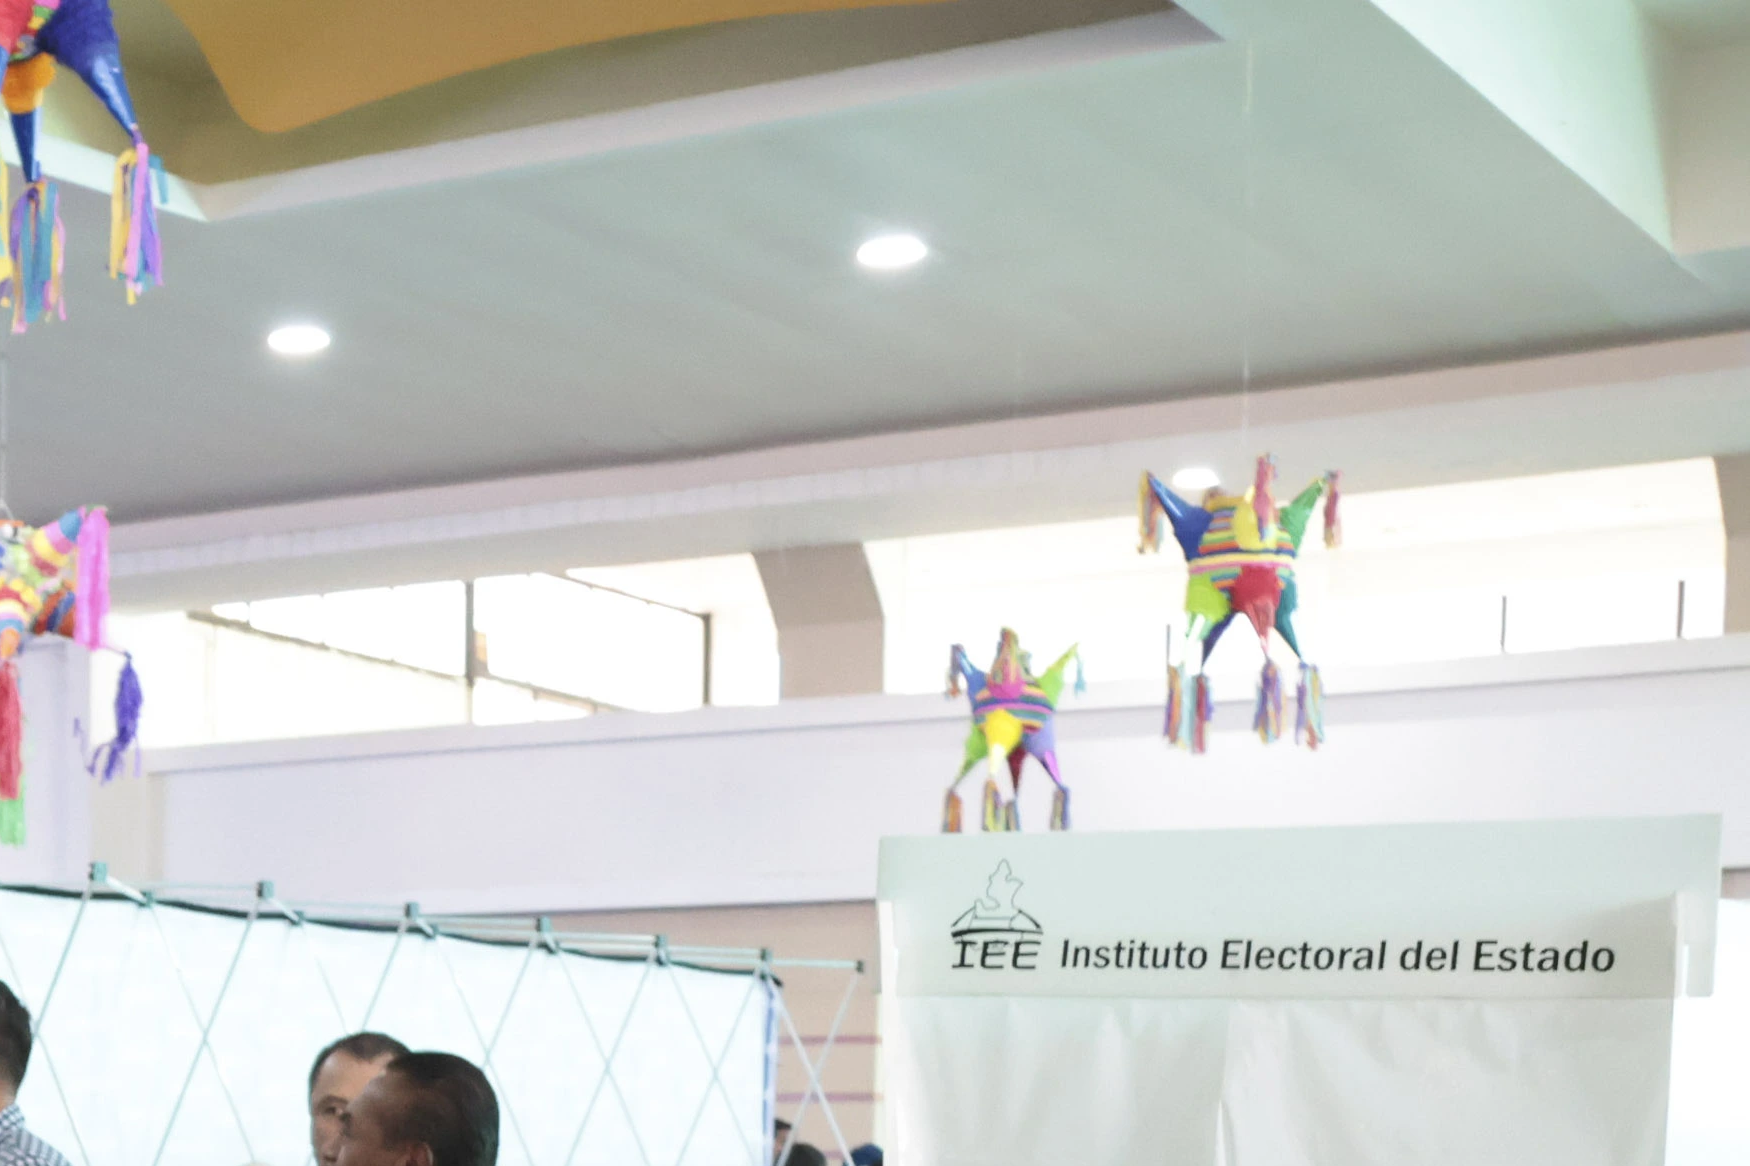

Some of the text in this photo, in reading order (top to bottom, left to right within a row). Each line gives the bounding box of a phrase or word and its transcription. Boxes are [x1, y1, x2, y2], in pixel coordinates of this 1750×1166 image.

[951, 940, 1042, 970] IEE
[1060, 939, 1615, 973] Instituto Electoral del Estado
